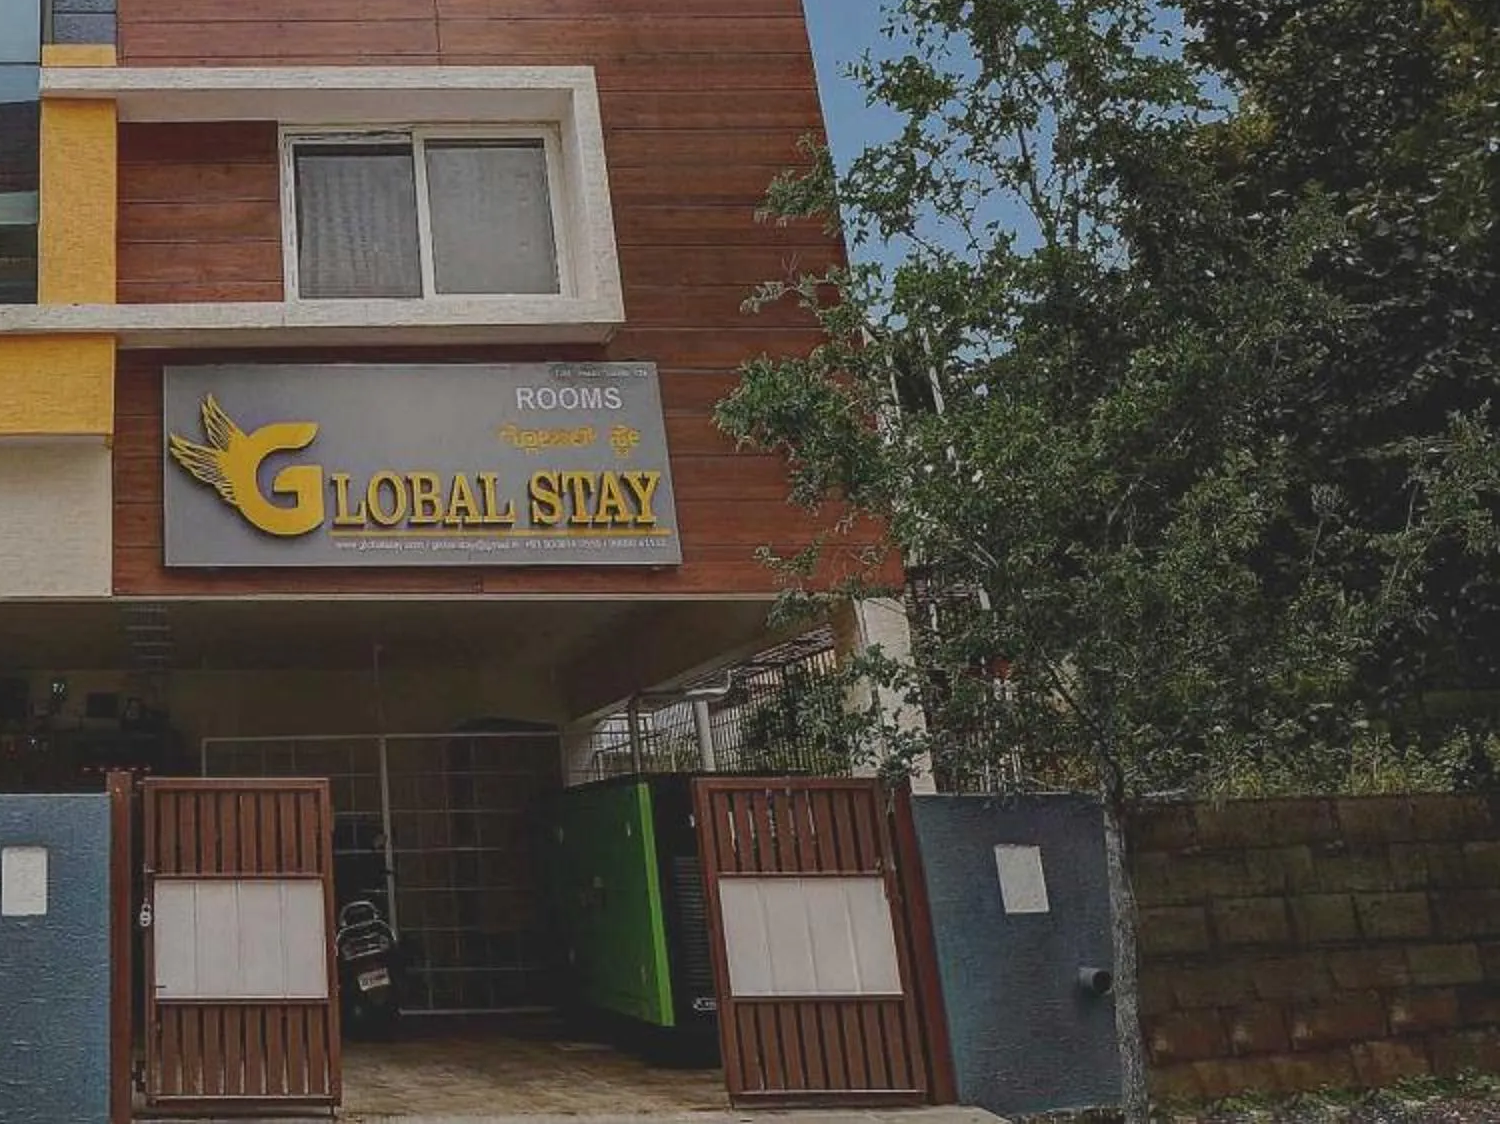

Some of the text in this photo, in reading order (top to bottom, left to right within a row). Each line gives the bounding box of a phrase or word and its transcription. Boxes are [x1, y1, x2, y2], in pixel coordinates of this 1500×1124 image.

[515, 386, 623, 410] ROOMS
[228, 421, 662, 536] GLOBAL STAY
